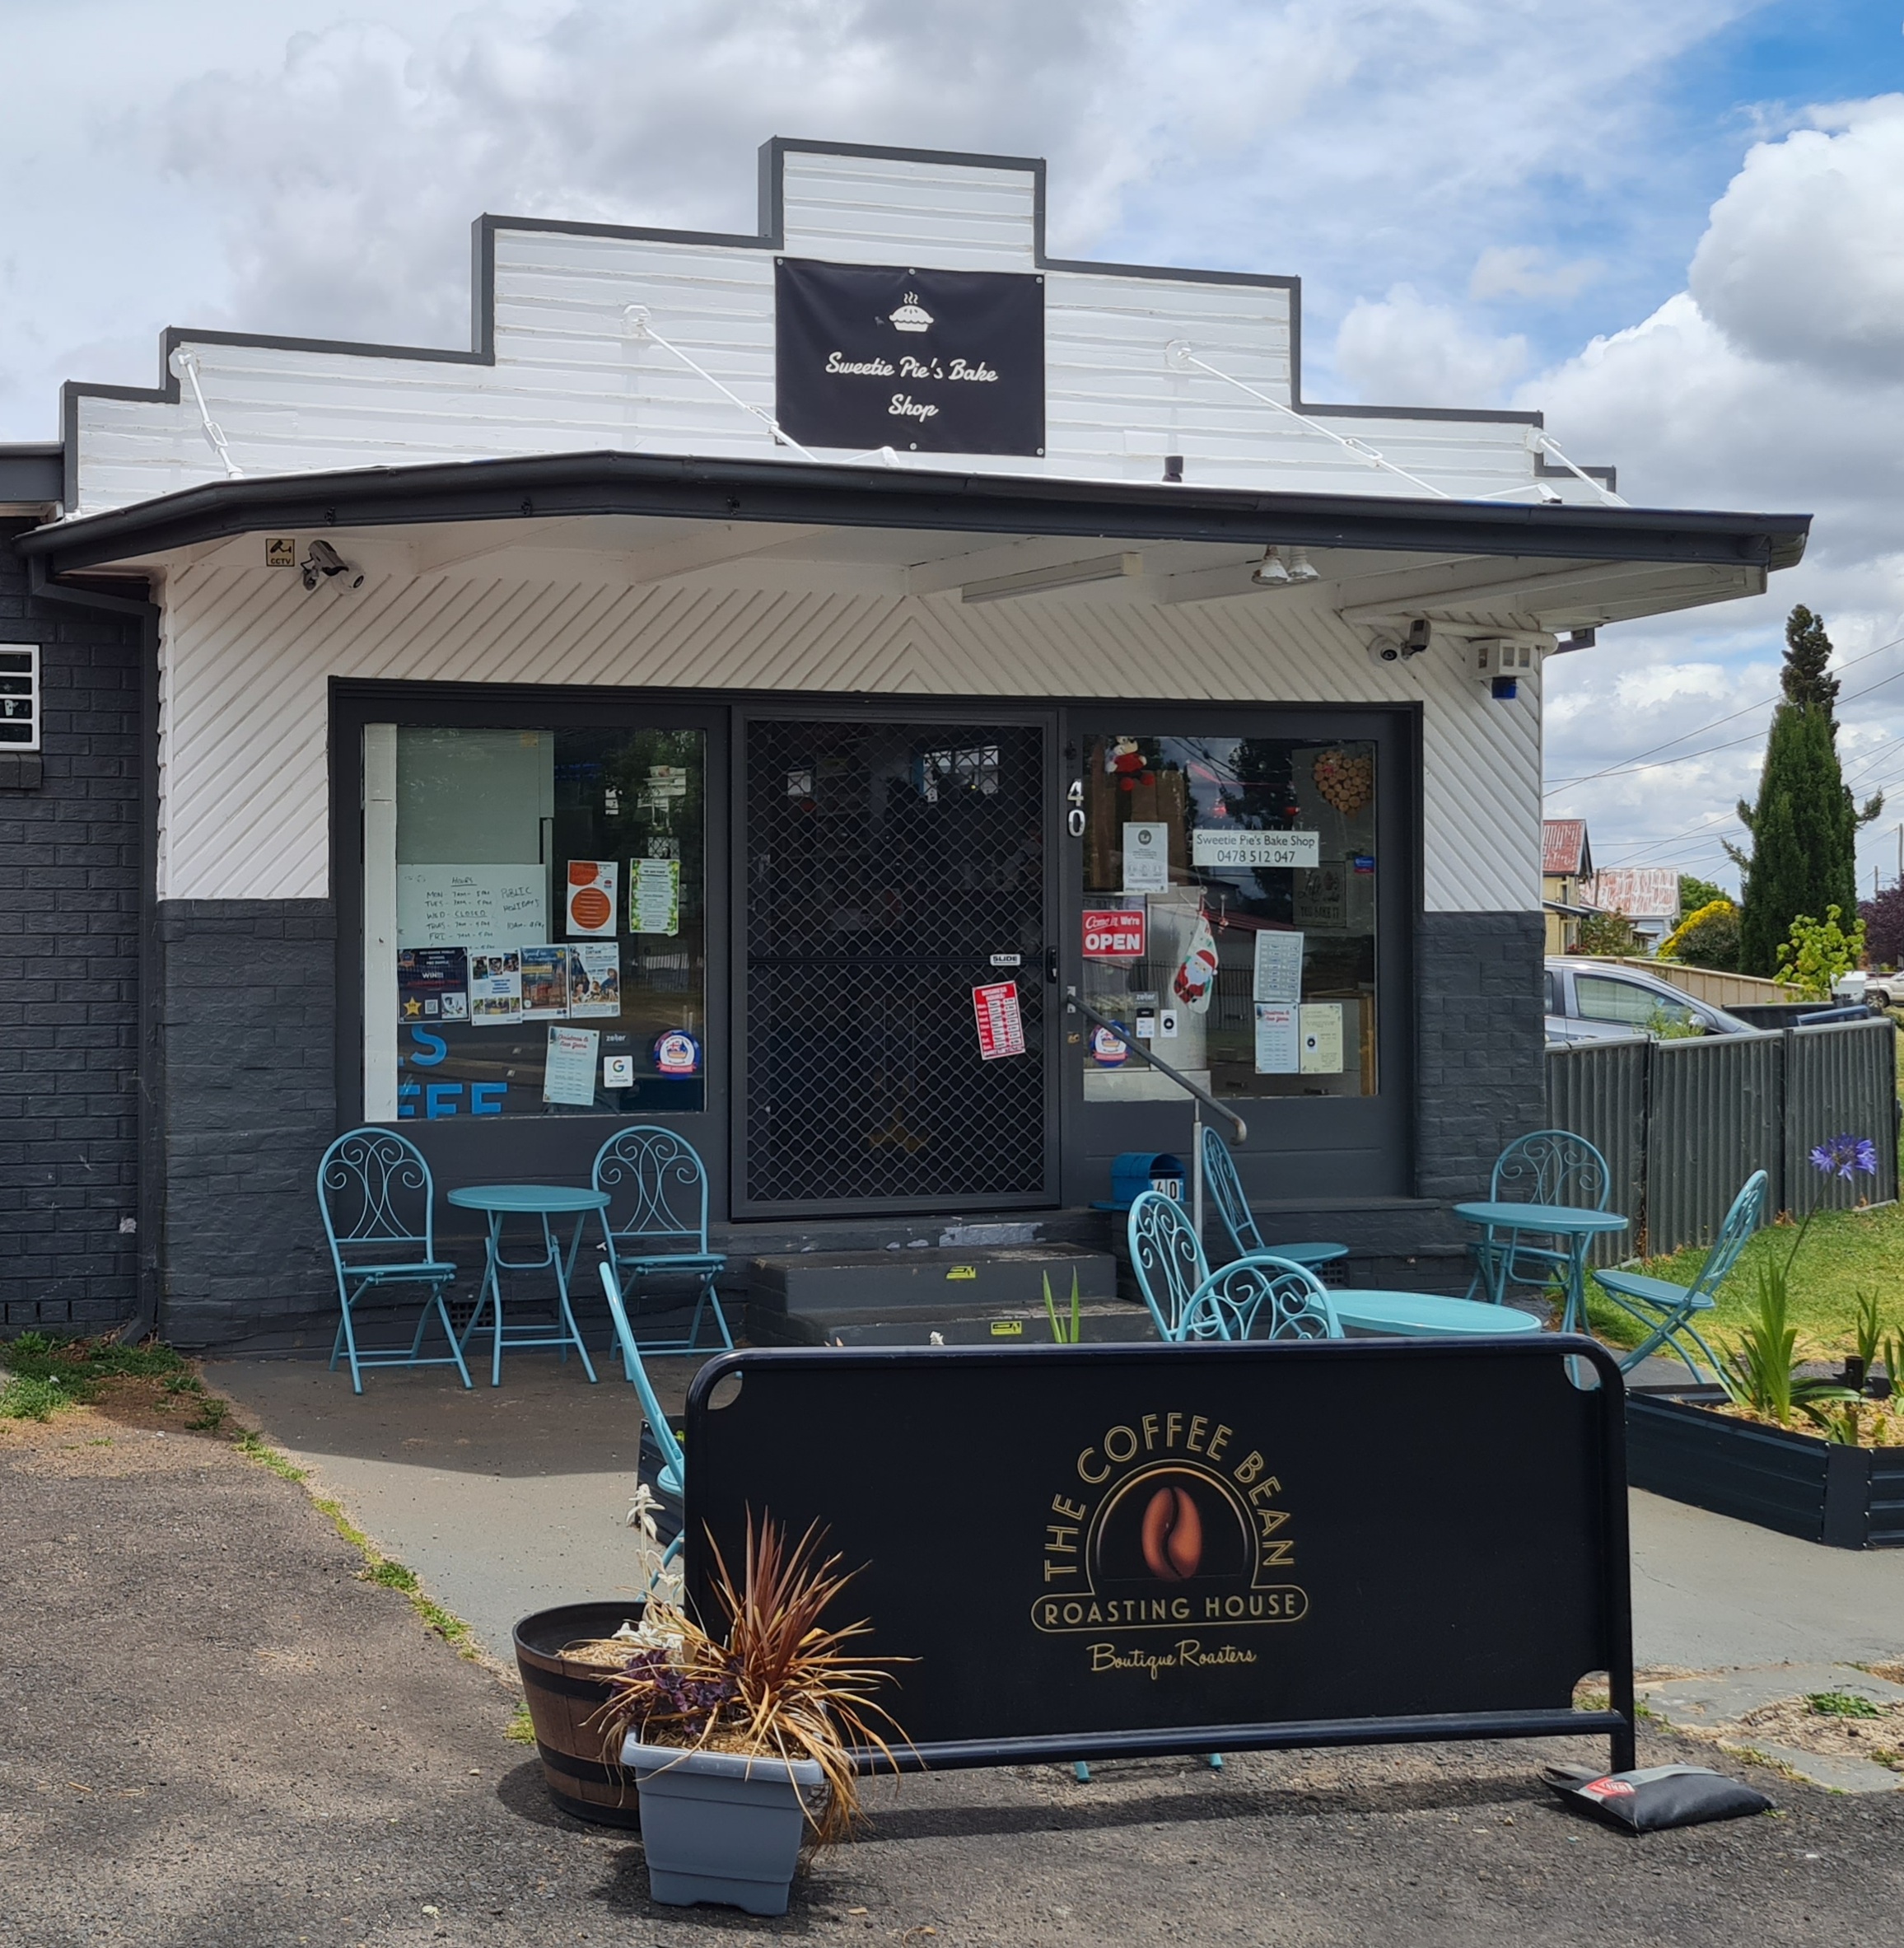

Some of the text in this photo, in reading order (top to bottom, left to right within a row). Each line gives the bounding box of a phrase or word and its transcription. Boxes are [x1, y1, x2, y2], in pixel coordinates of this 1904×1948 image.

[825, 352, 998, 382] Sweetie Pie's Bake
[888, 393, 939, 423] Shop
[1197, 834, 1315, 849] Sweetie Pie's Bake Shop
[1216, 850, 1295, 863] 0478 512 047
[500, 886, 532, 899] PUBLIC
[455, 909, 486, 918] CLOSED
[1085, 933, 1140, 951] OPEN
[1043, 1412, 1295, 1582] THE COFFEE BEAN
[1044, 1593, 1295, 1625] ROASTING HOUSE
[1086, 1639, 1258, 1680] Boutique Roasters
